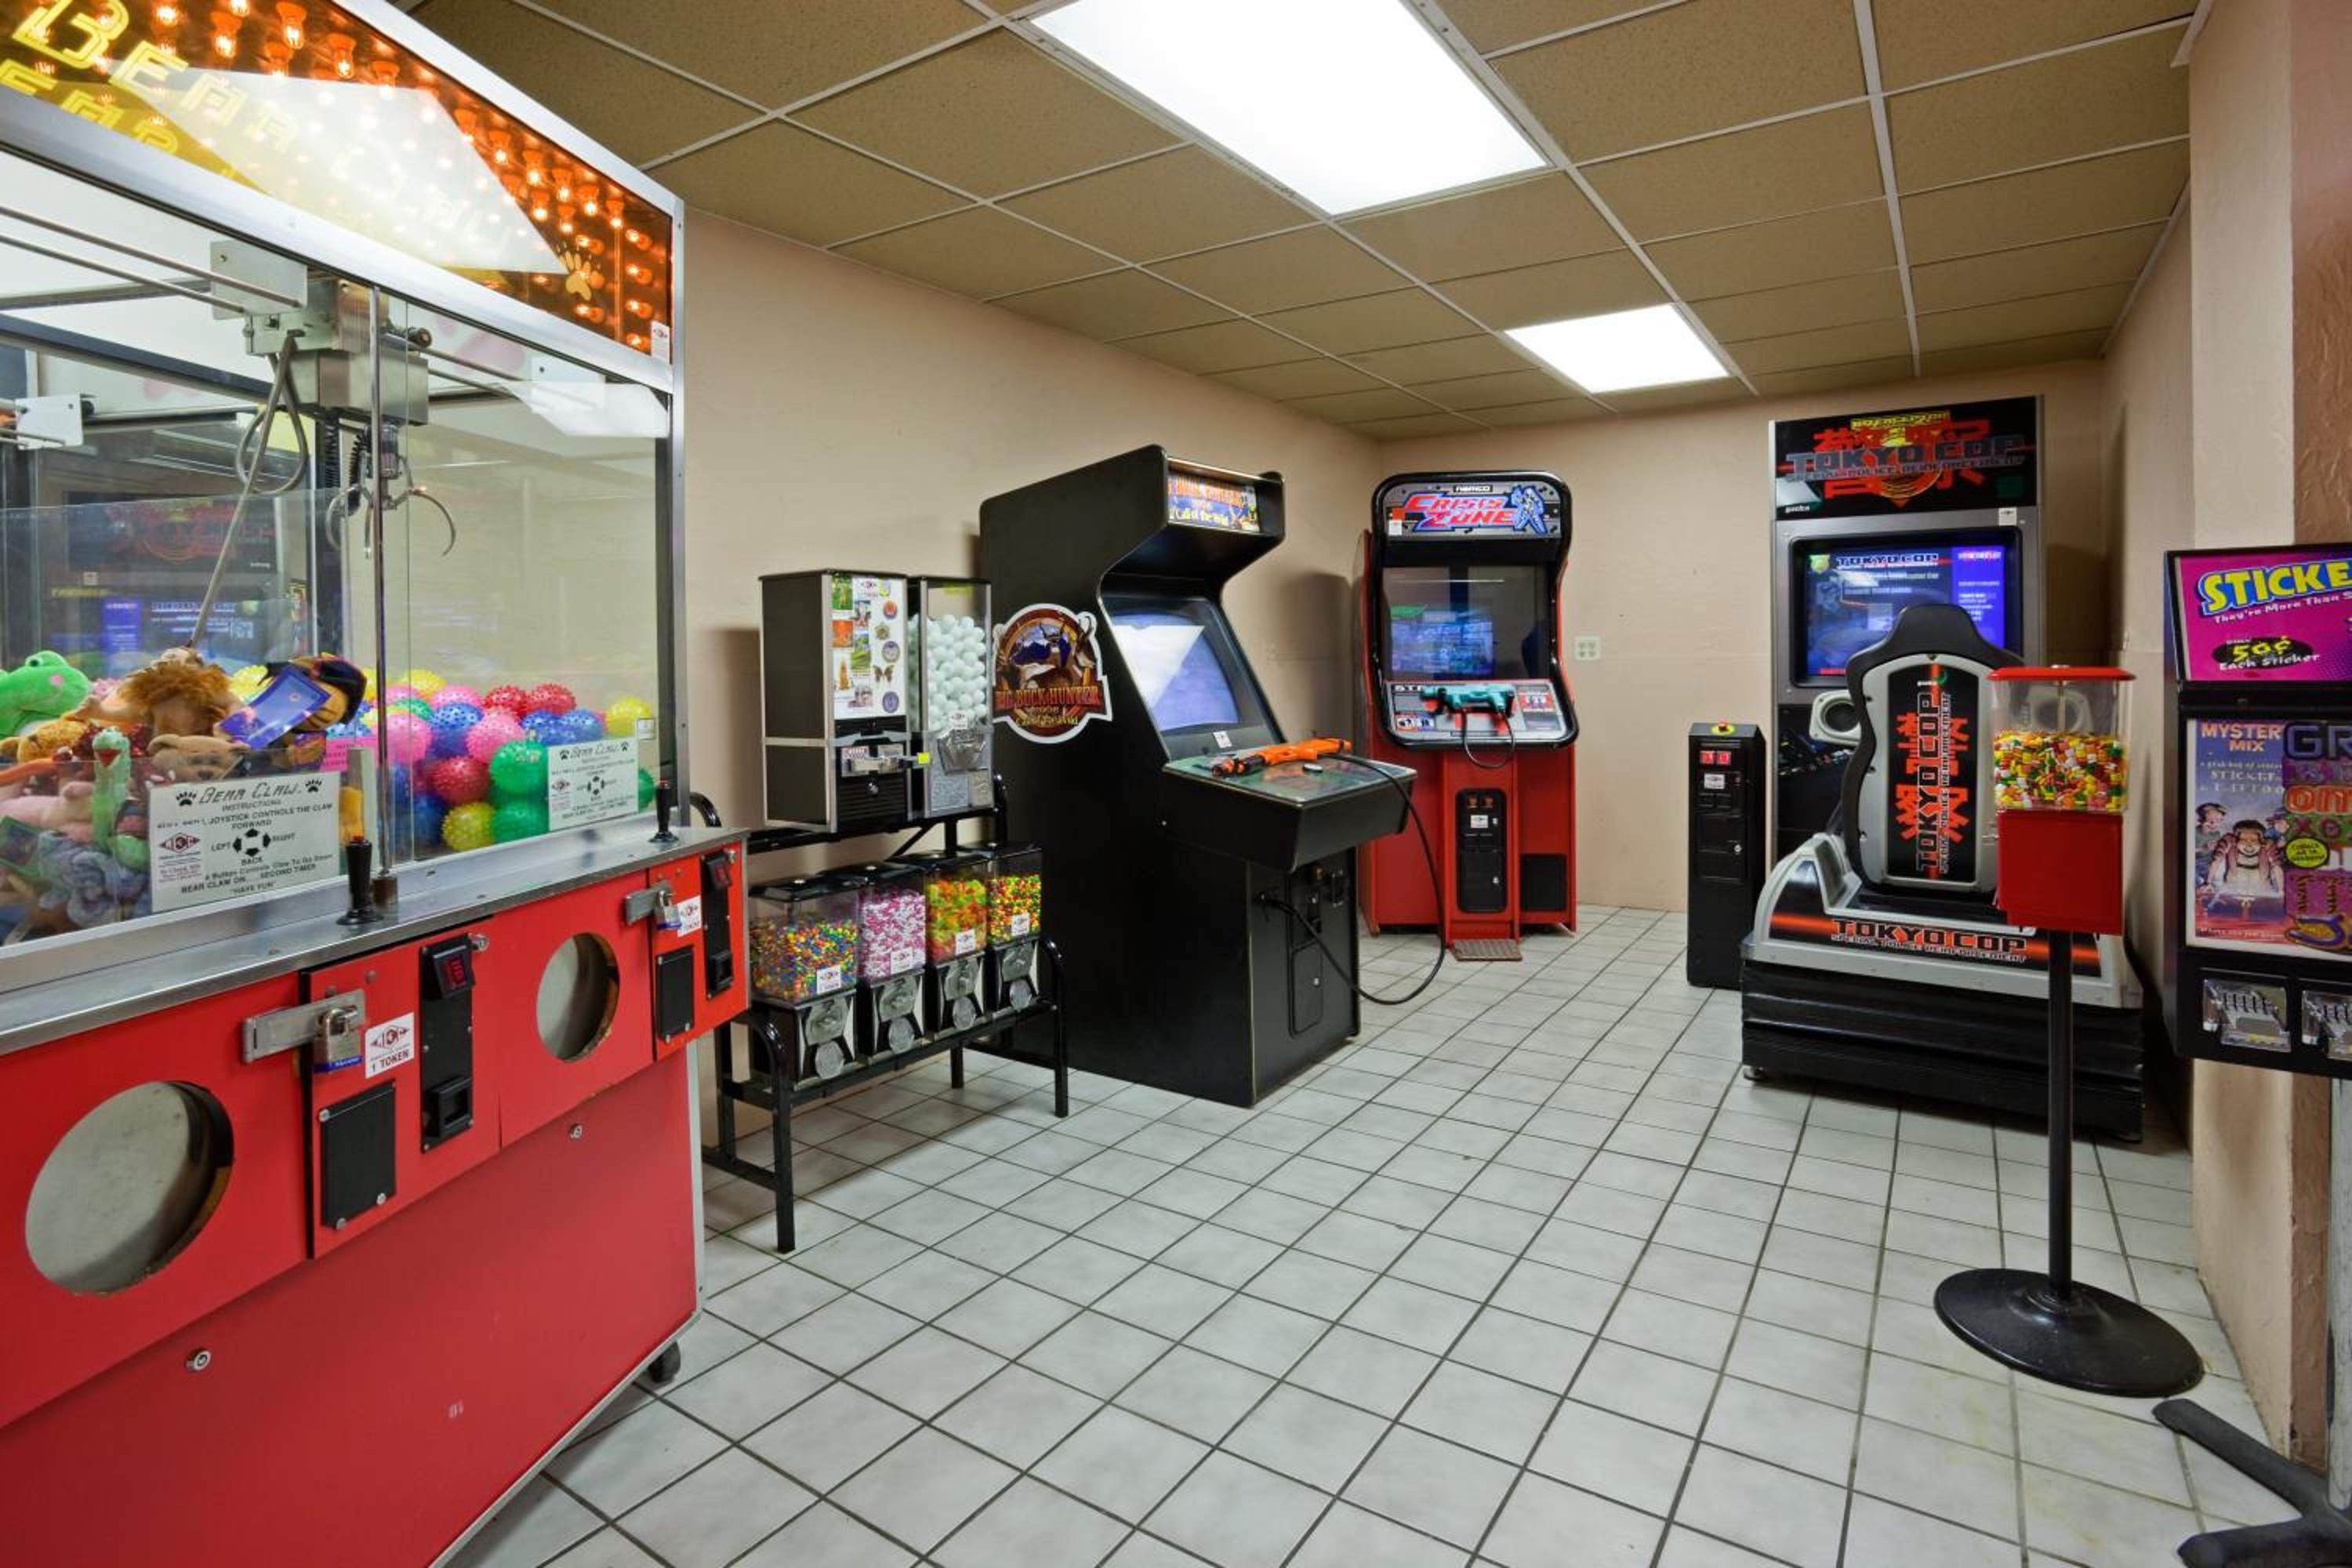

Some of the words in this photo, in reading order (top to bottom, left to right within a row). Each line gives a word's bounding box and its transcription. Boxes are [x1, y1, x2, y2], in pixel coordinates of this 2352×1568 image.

[1786, 445, 1924, 476] TOKYO
[2214, 608, 2262, 624] They're
[2265, 601, 2301, 614] More
[2305, 594, 2339, 607] Than
[2220, 659, 2256, 670] Each
[2261, 652, 2321, 667] Sticker
[1916, 691, 1940, 759] COP
[2229, 739, 2264, 752] MIX
[209, 814, 249, 824] JOYSTICK
[252, 808, 294, 818] CONTROLS
[1916, 765, 1940, 871] TOKYO
[211, 841, 230, 851] LEFT
[241, 856, 263, 866] BACK
[1831, 919, 1947, 947] TOKYO
[1951, 931, 2027, 953] COP
[379, 1049, 409, 1068] TOKEN
